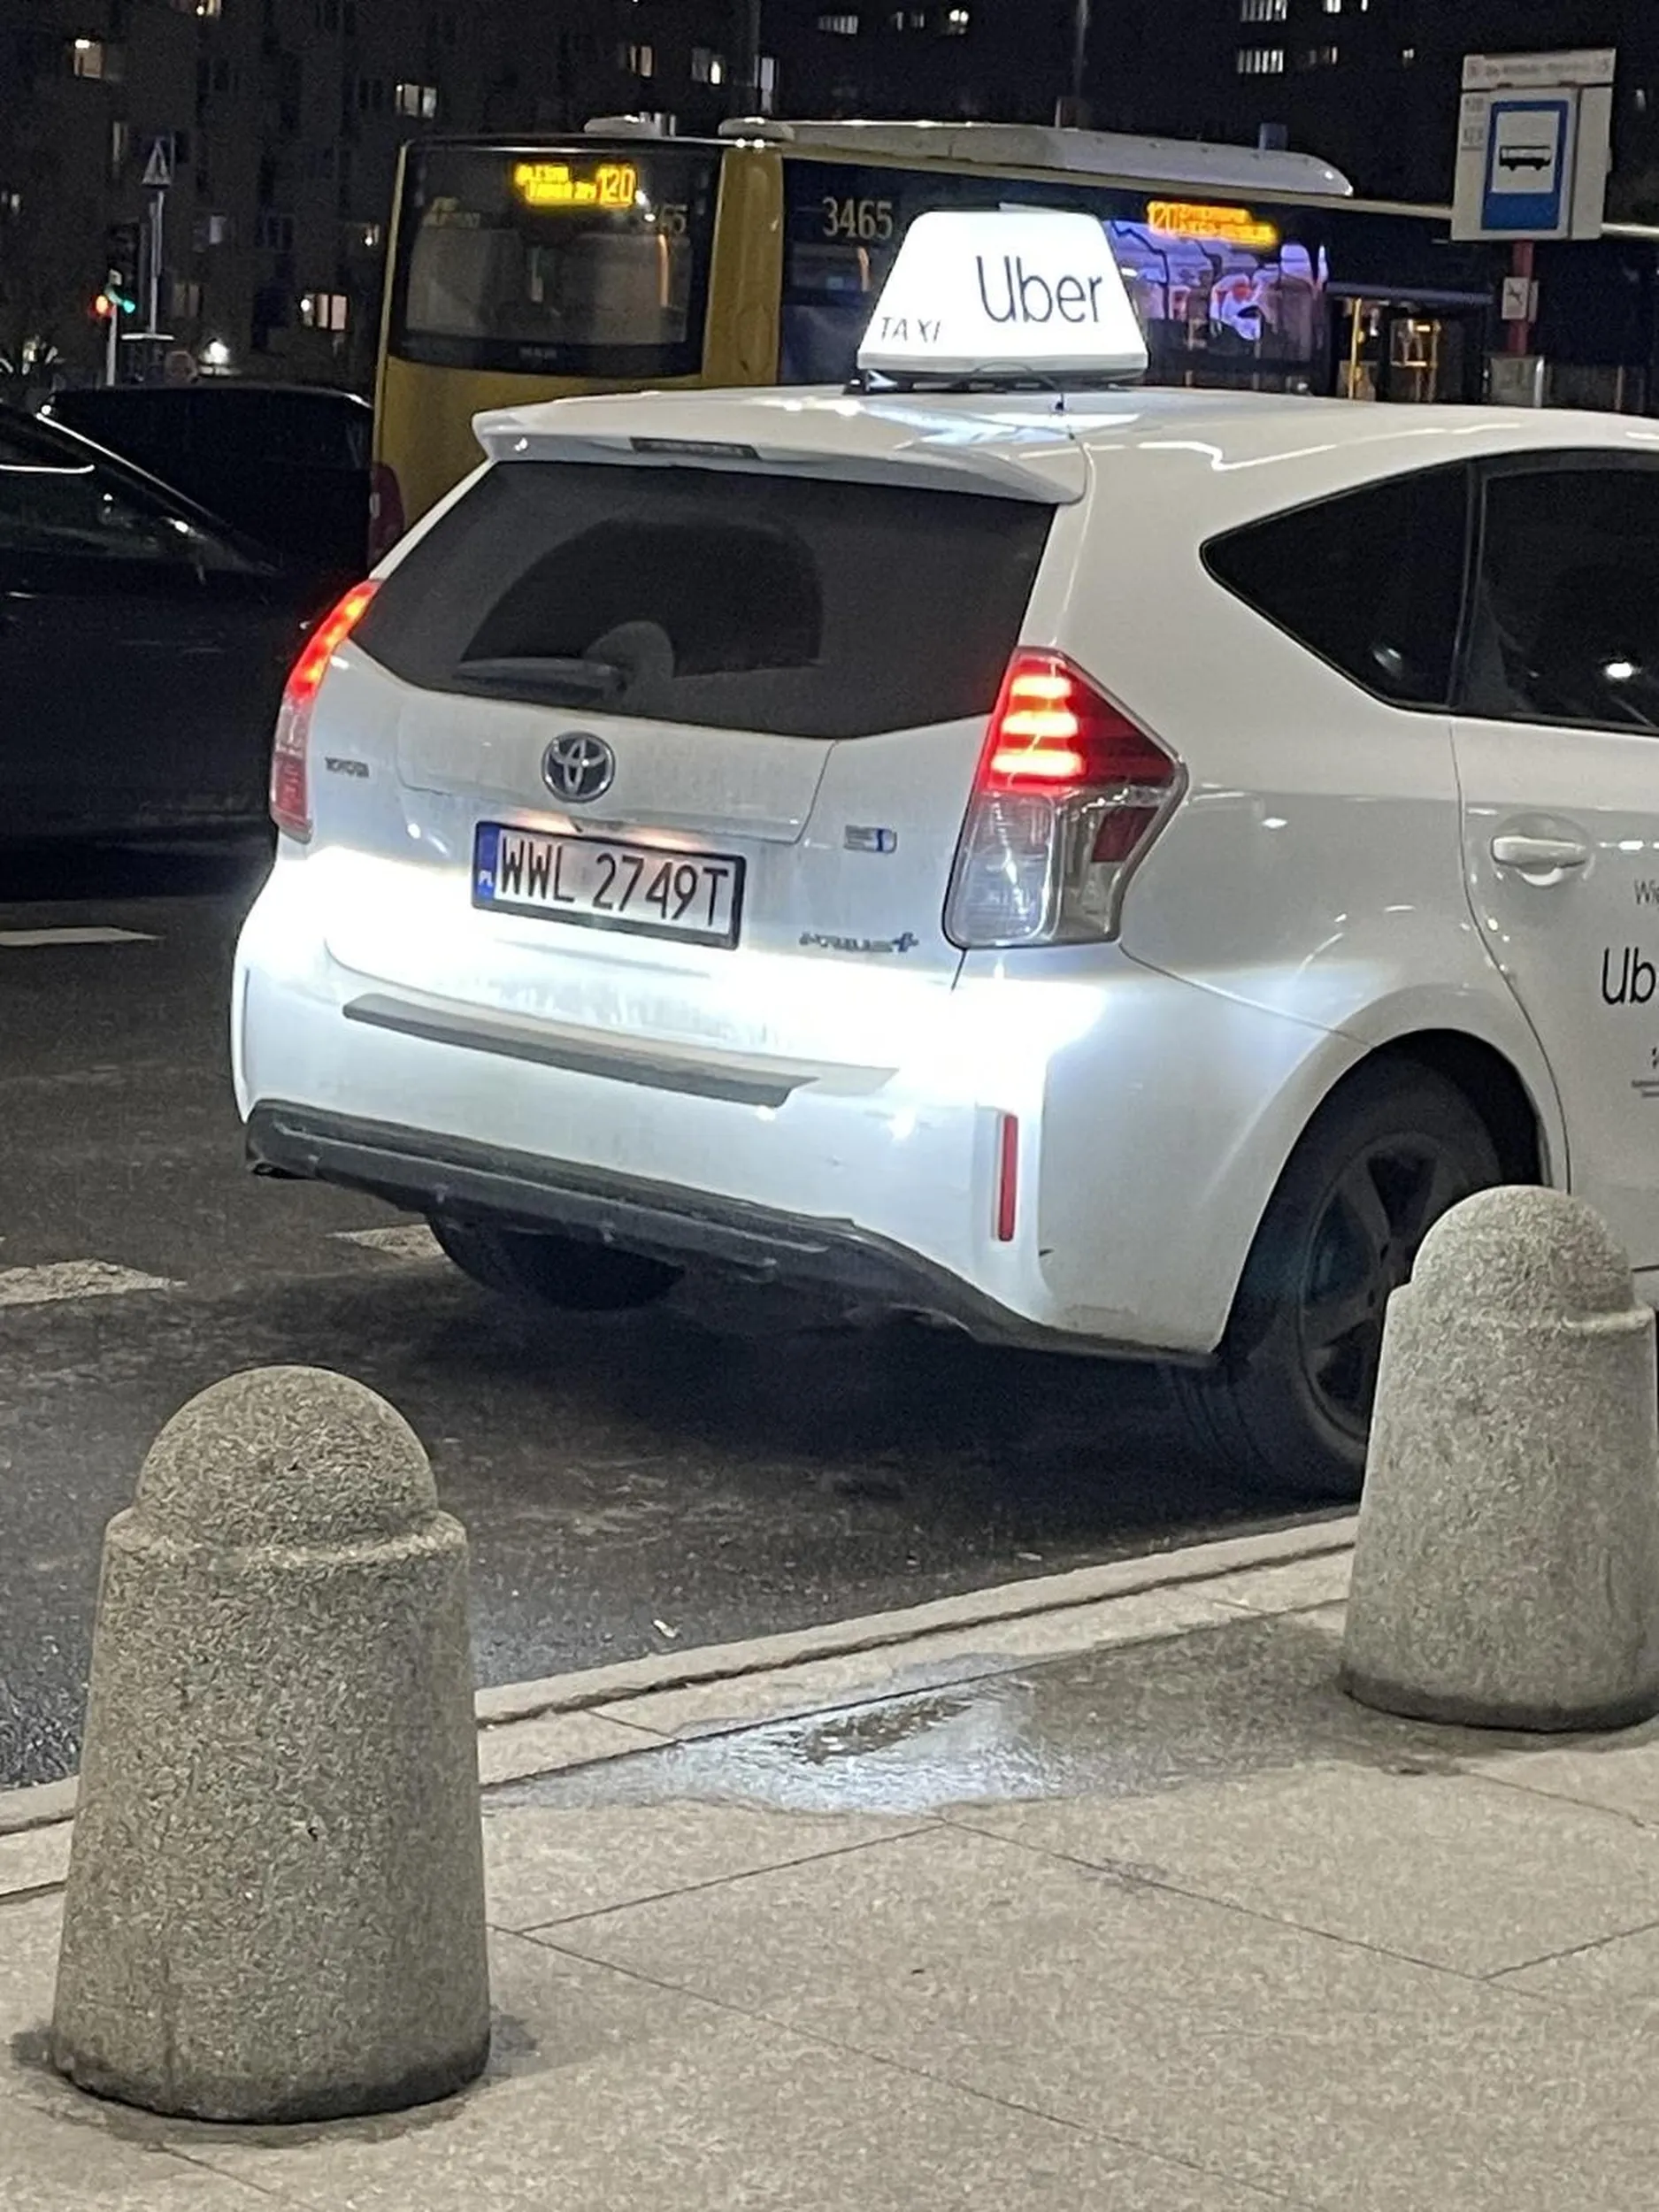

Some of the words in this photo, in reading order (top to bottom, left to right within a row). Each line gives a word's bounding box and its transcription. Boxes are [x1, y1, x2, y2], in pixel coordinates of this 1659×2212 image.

[596, 163, 637, 208] 120
[822, 196, 894, 241] 3465
[976, 255, 1102, 324] Uber
[880, 316, 942, 343] TAXI
[501, 837, 575, 903] WWL
[592, 852, 729, 927] 2749T
[1601, 946, 1656, 1005] Ub
